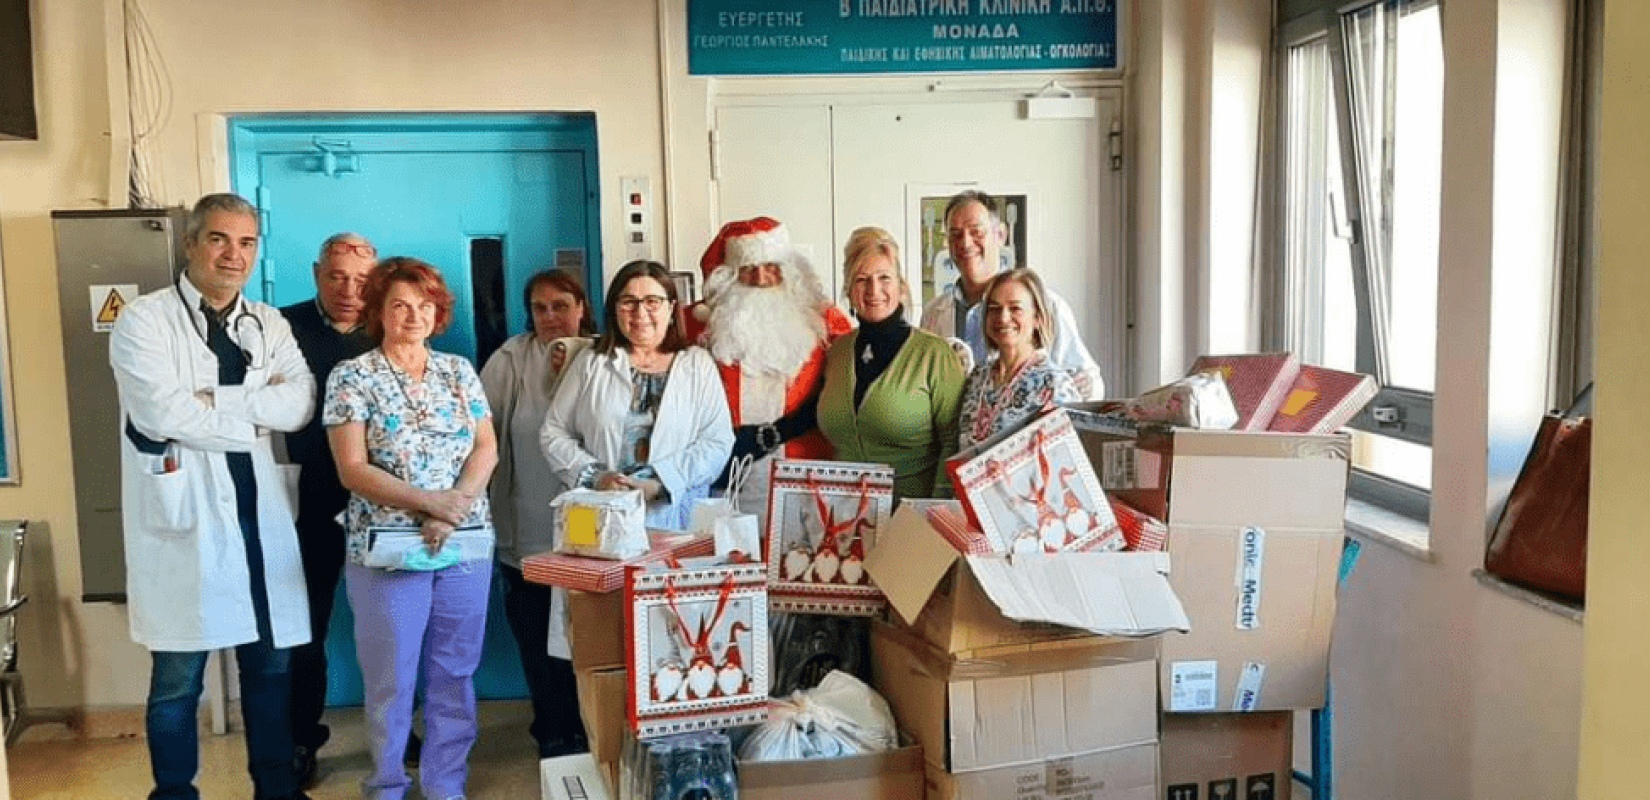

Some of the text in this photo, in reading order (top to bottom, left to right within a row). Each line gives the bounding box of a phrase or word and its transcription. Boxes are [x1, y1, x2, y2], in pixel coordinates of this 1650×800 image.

[719, 11, 803, 27] ΕΥΕΡΓΕΤΗΣ
[933, 23, 1019, 38] ΜΟΝΑΔΑ
[694, 35, 750, 49] ΓΕΩΡΓΙΟΣ
[892, 48, 910, 61] ΚΑΙ
[970, 45, 1041, 60] ΑΙΜΑΤΟΛΟΓΙΑΣ
